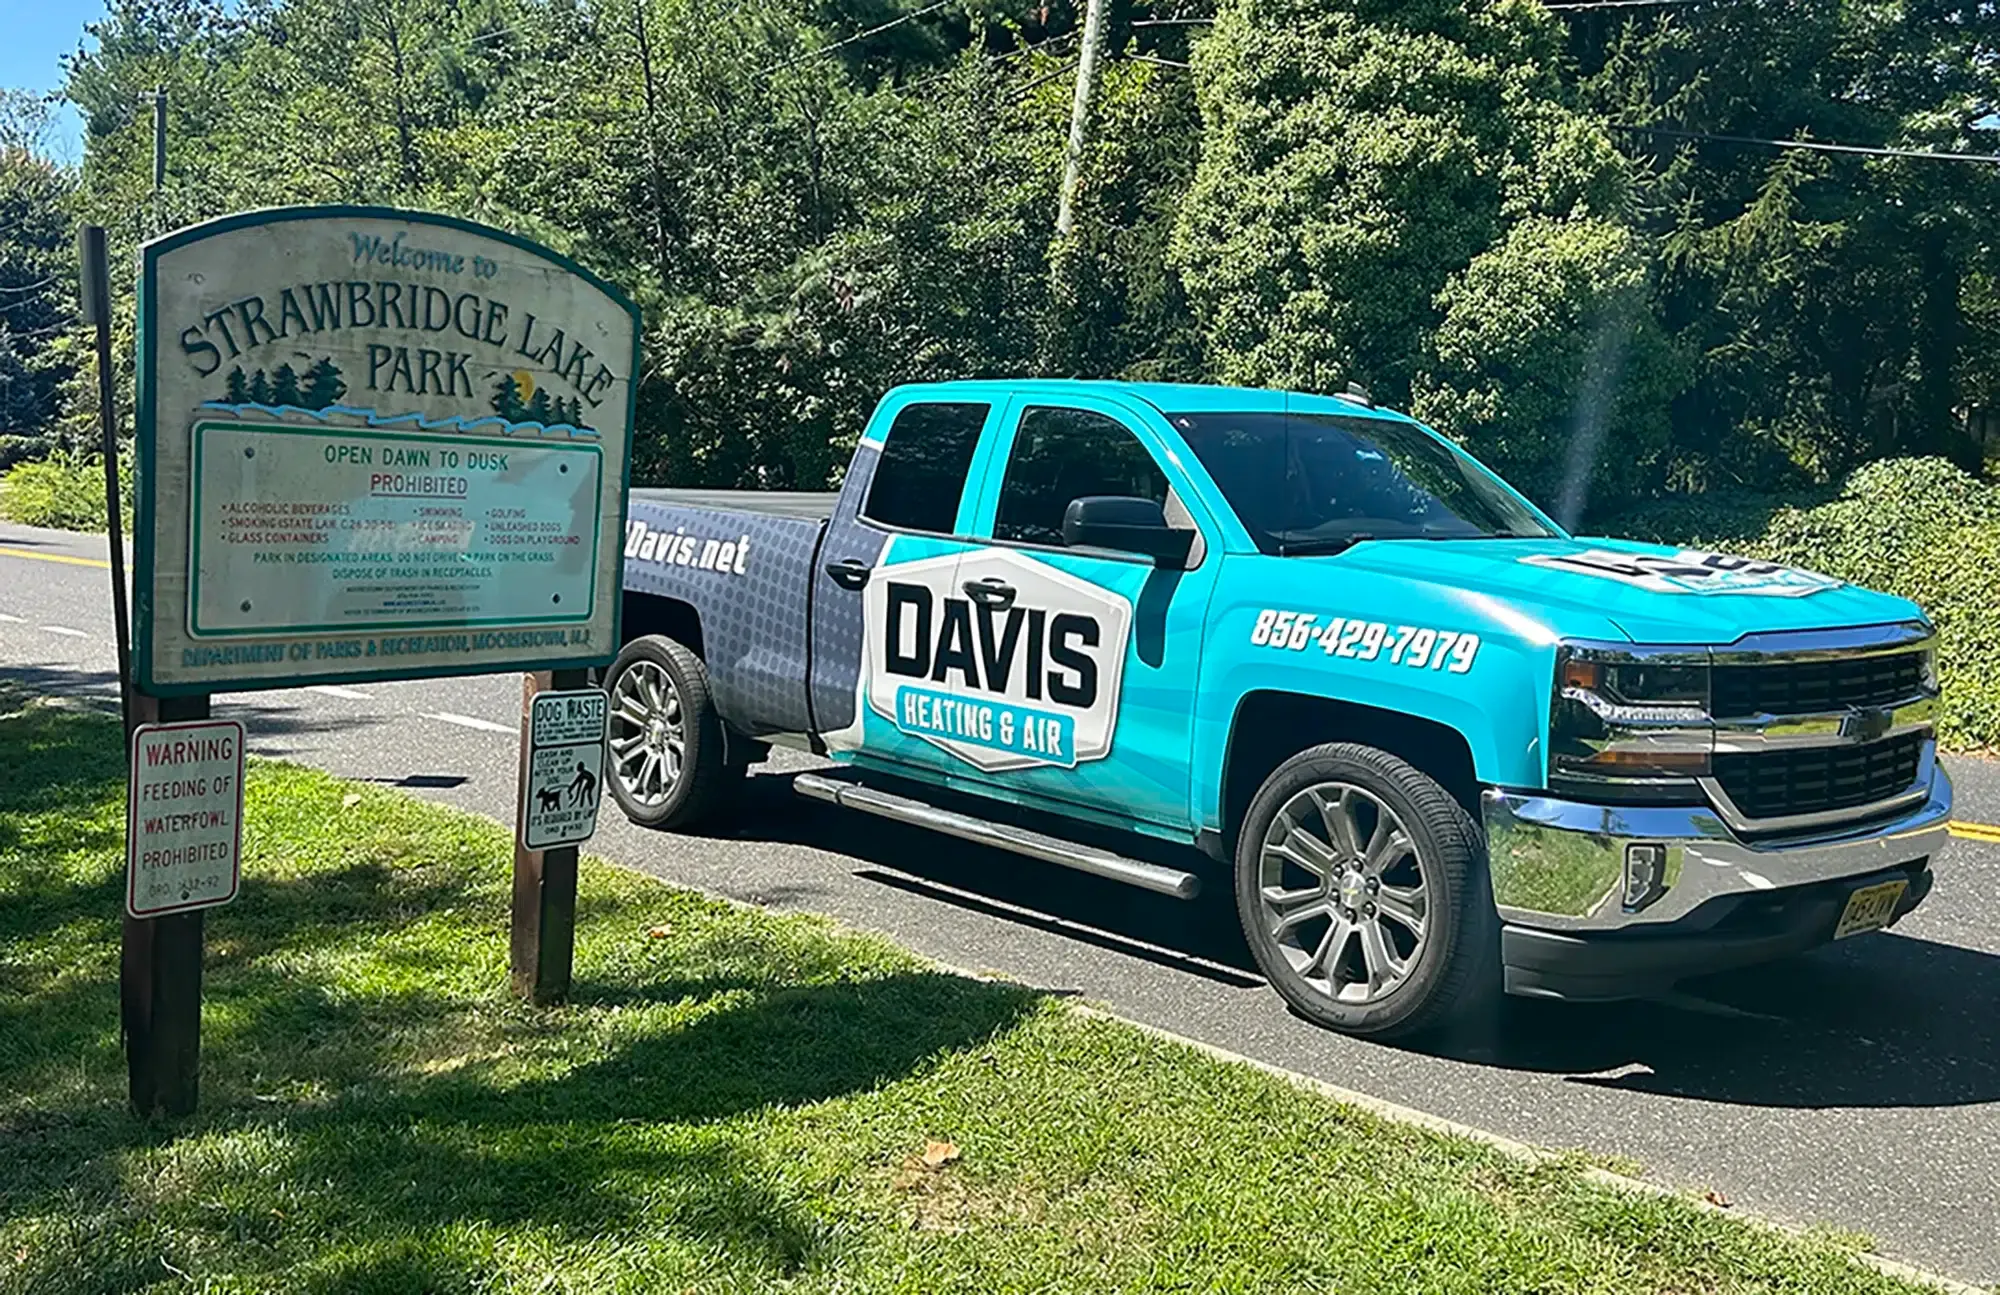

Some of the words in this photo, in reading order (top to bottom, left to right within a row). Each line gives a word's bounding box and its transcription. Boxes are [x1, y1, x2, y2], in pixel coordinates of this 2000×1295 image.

[349, 231, 465, 276] Welcome
[475, 254, 499, 279] to
[180, 280, 509, 378] STRAWBRIDGE
[518, 313, 617, 408] LAKE
[367, 344, 475, 398] PARK
[324, 445, 373, 464] OPEN
[382, 447, 430, 468] DAWN
[440, 451, 459, 469] TO
[468, 452, 509, 471] DUSK
[370, 473, 468, 494] PROHIBITED
[228, 502, 289, 514] ALCOHOLIC
[292, 504, 350, 516] BEVERAGES
[228, 517, 276, 529] SMOKING
[228, 531, 263, 544] GLASS
[265, 532, 329, 544] CONTAINERS
[624, 519, 751, 576] Davis.net
[182, 644, 286, 668] DEPARTMENT
[289, 642, 314, 662] OF
[316, 639, 361, 660] PARKS
[364, 639, 377, 657] &
[885, 581, 1100, 709] DAVIS
[537, 702, 562, 722] DOG
[567, 699, 604, 719] WASTE
[904, 692, 993, 741] HEATING
[1000, 711, 1015, 746] &
[1023, 714, 1064, 757] AIR
[146, 737, 233, 766] WARNING
[536, 749, 558, 760] LEASH
[560, 748, 574, 758] AND
[143, 779, 207, 801] FEEDING
[213, 776, 232, 795] OF
[144, 811, 229, 835] WATERFOWL
[142, 842, 229, 870] PROHIBITED
